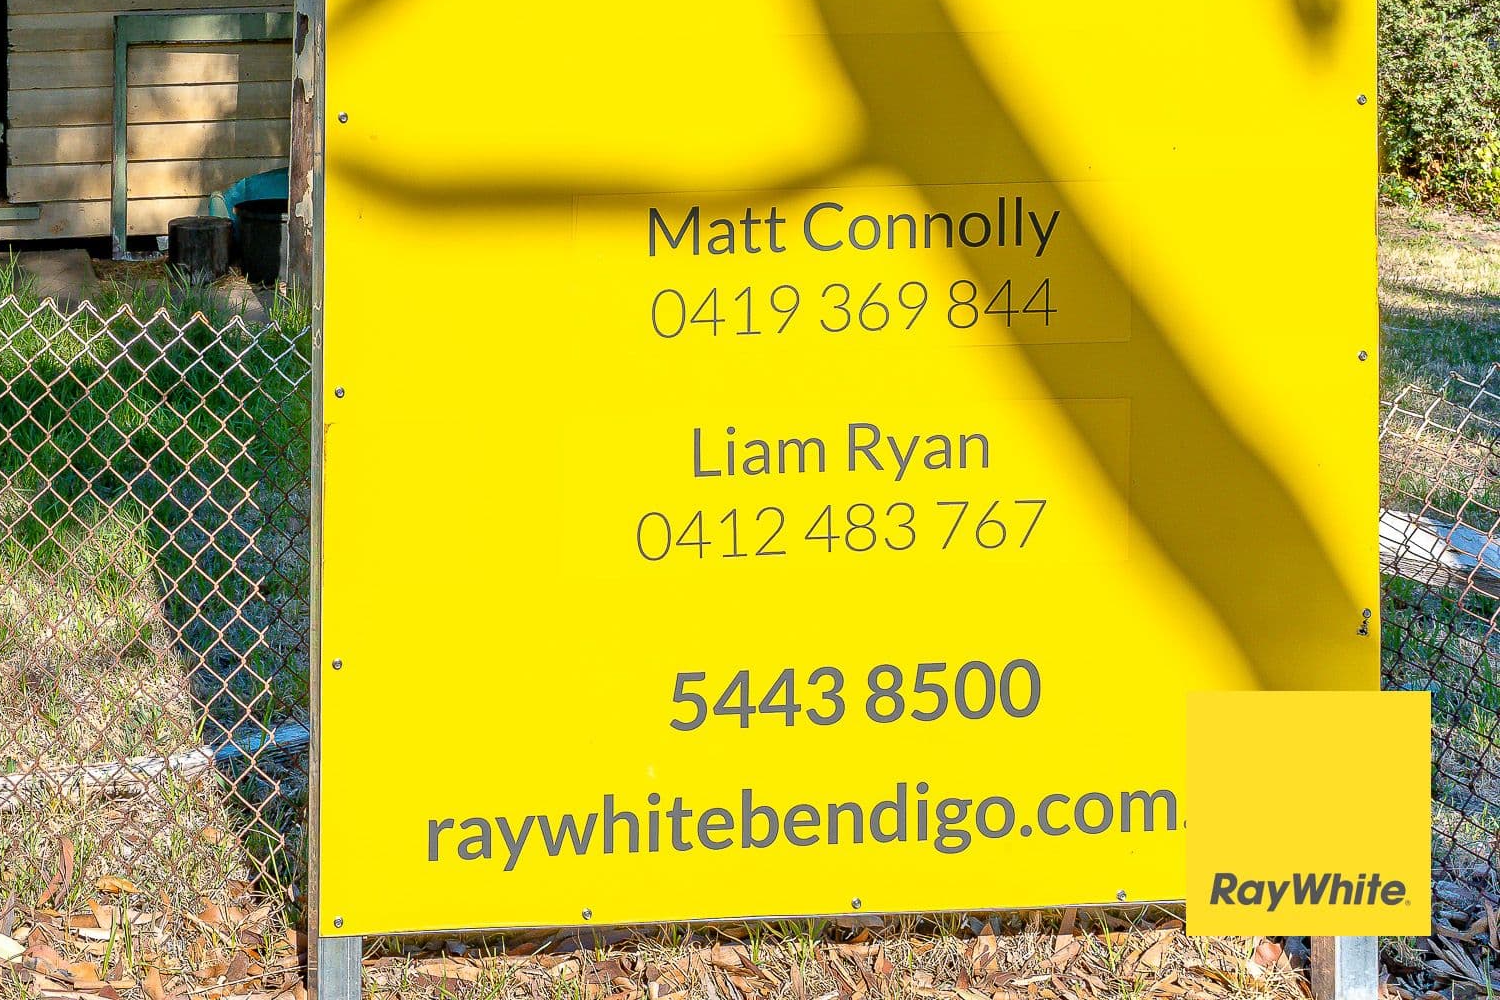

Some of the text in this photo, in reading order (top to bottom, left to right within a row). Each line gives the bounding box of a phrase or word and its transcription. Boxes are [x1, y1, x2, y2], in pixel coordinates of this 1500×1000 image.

[647, 195, 1062, 258] Matt Connolly
[650, 276, 1059, 340] 0419 369 844
[692, 420, 990, 483] Liam Ryan
[635, 498, 1048, 562] 0412 483 767
[668, 658, 1043, 732] 5443 8500
[426, 780, 1187, 873] raywhitebendigo.com
